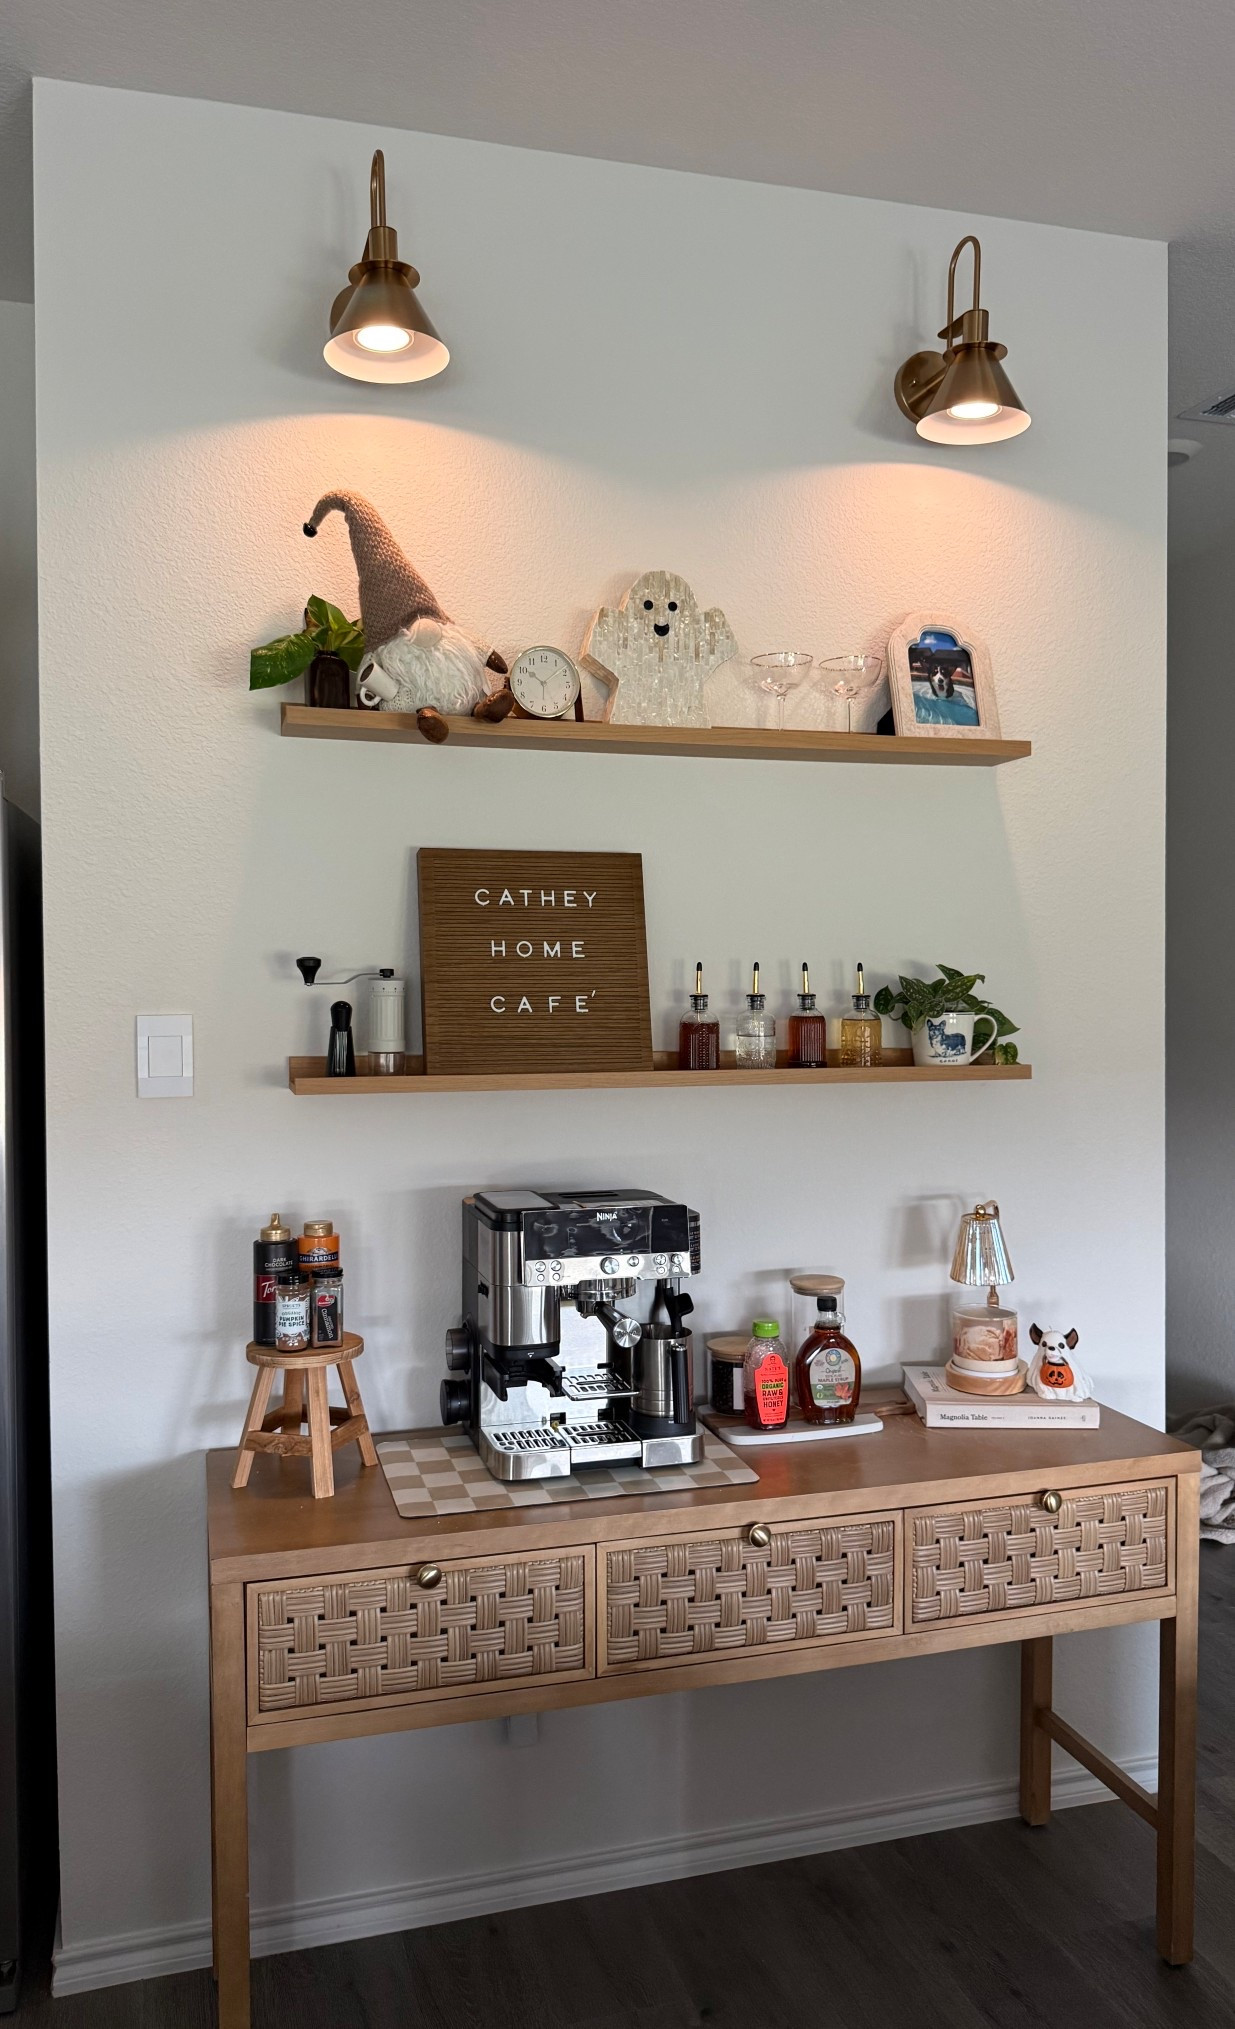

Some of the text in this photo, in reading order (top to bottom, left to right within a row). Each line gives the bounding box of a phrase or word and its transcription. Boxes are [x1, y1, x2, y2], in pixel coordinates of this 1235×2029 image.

[475, 888, 596, 908] CATHEY
[491, 940, 586, 958] HOME
[596, 1212, 618, 1221] NINJA
[262, 1280, 277, 1298] Tor
